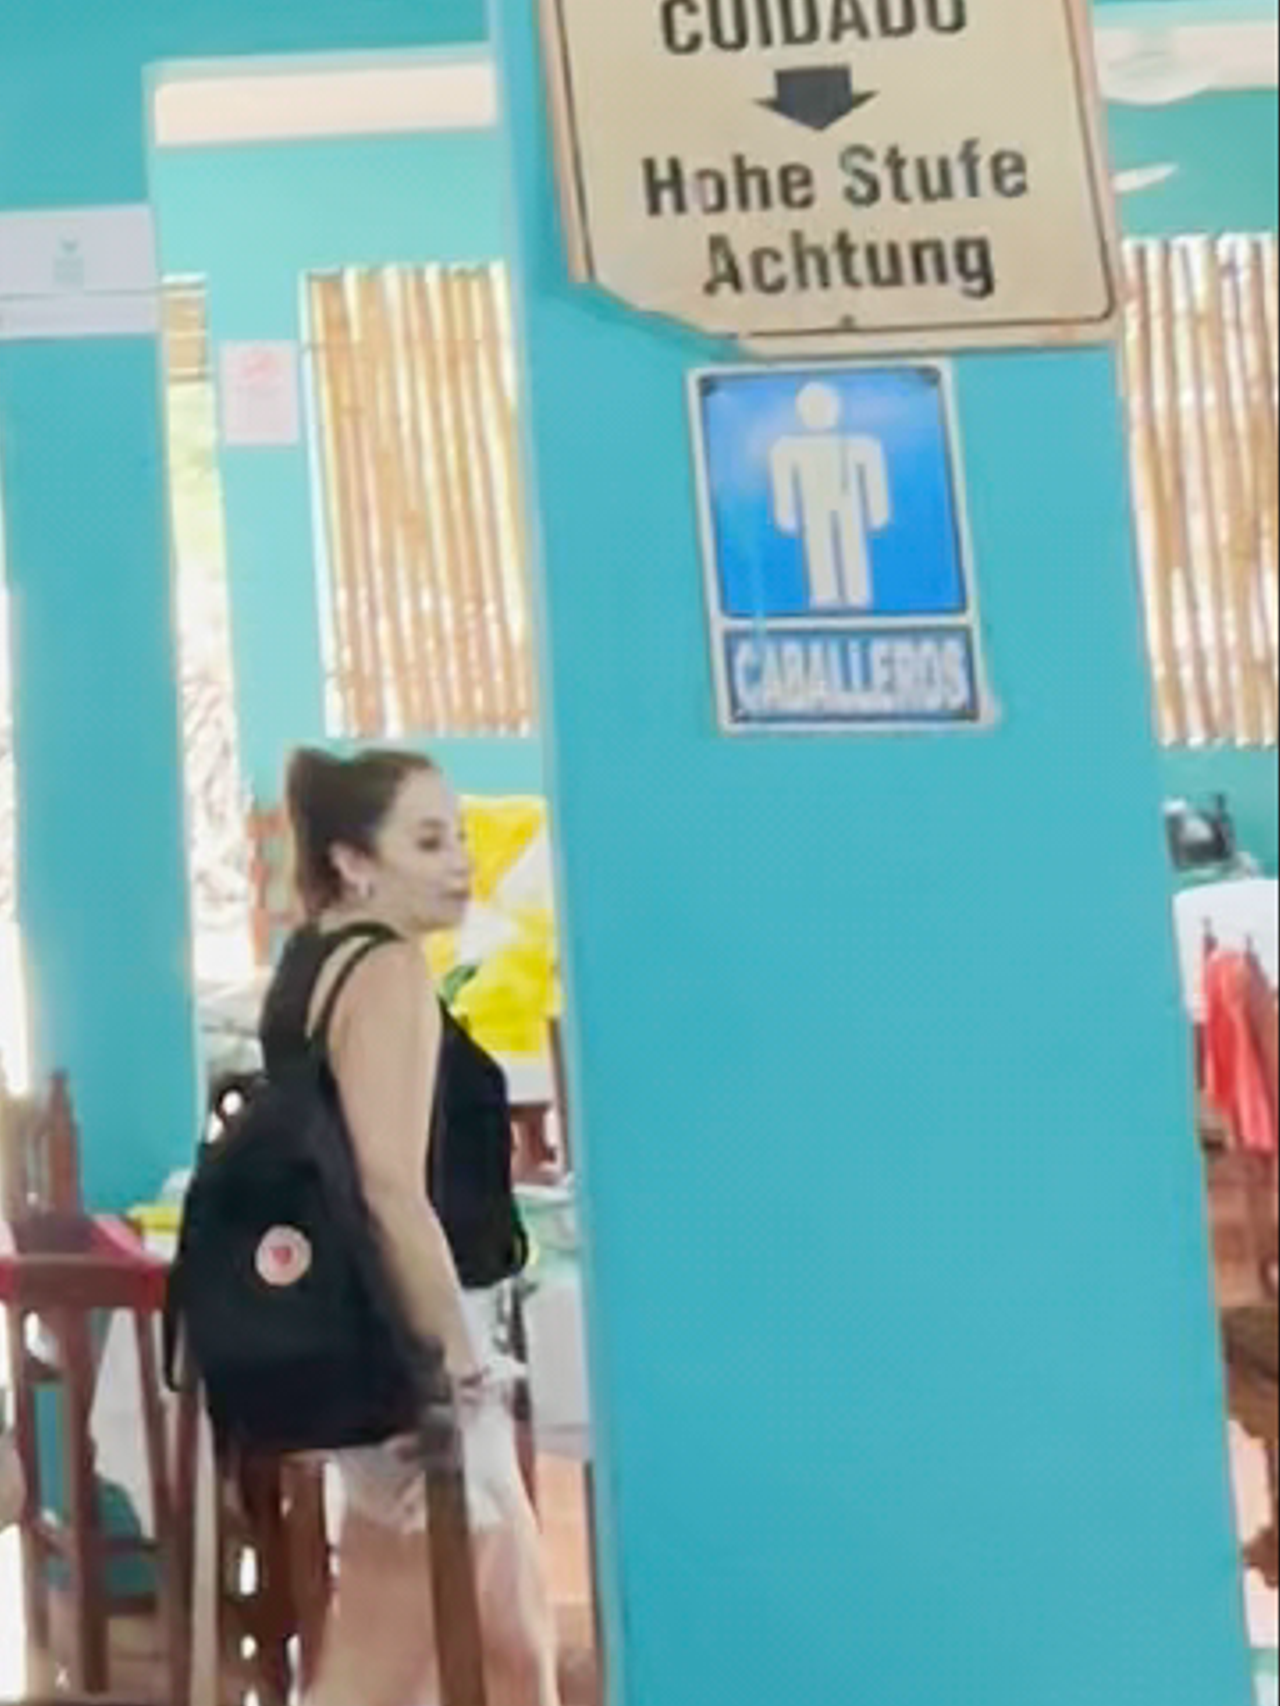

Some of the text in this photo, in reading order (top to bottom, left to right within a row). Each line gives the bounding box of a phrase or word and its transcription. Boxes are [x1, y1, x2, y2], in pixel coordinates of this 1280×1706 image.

[640, 137, 1029, 219] Hohe Stufe
[701, 228, 997, 302] Achtung
